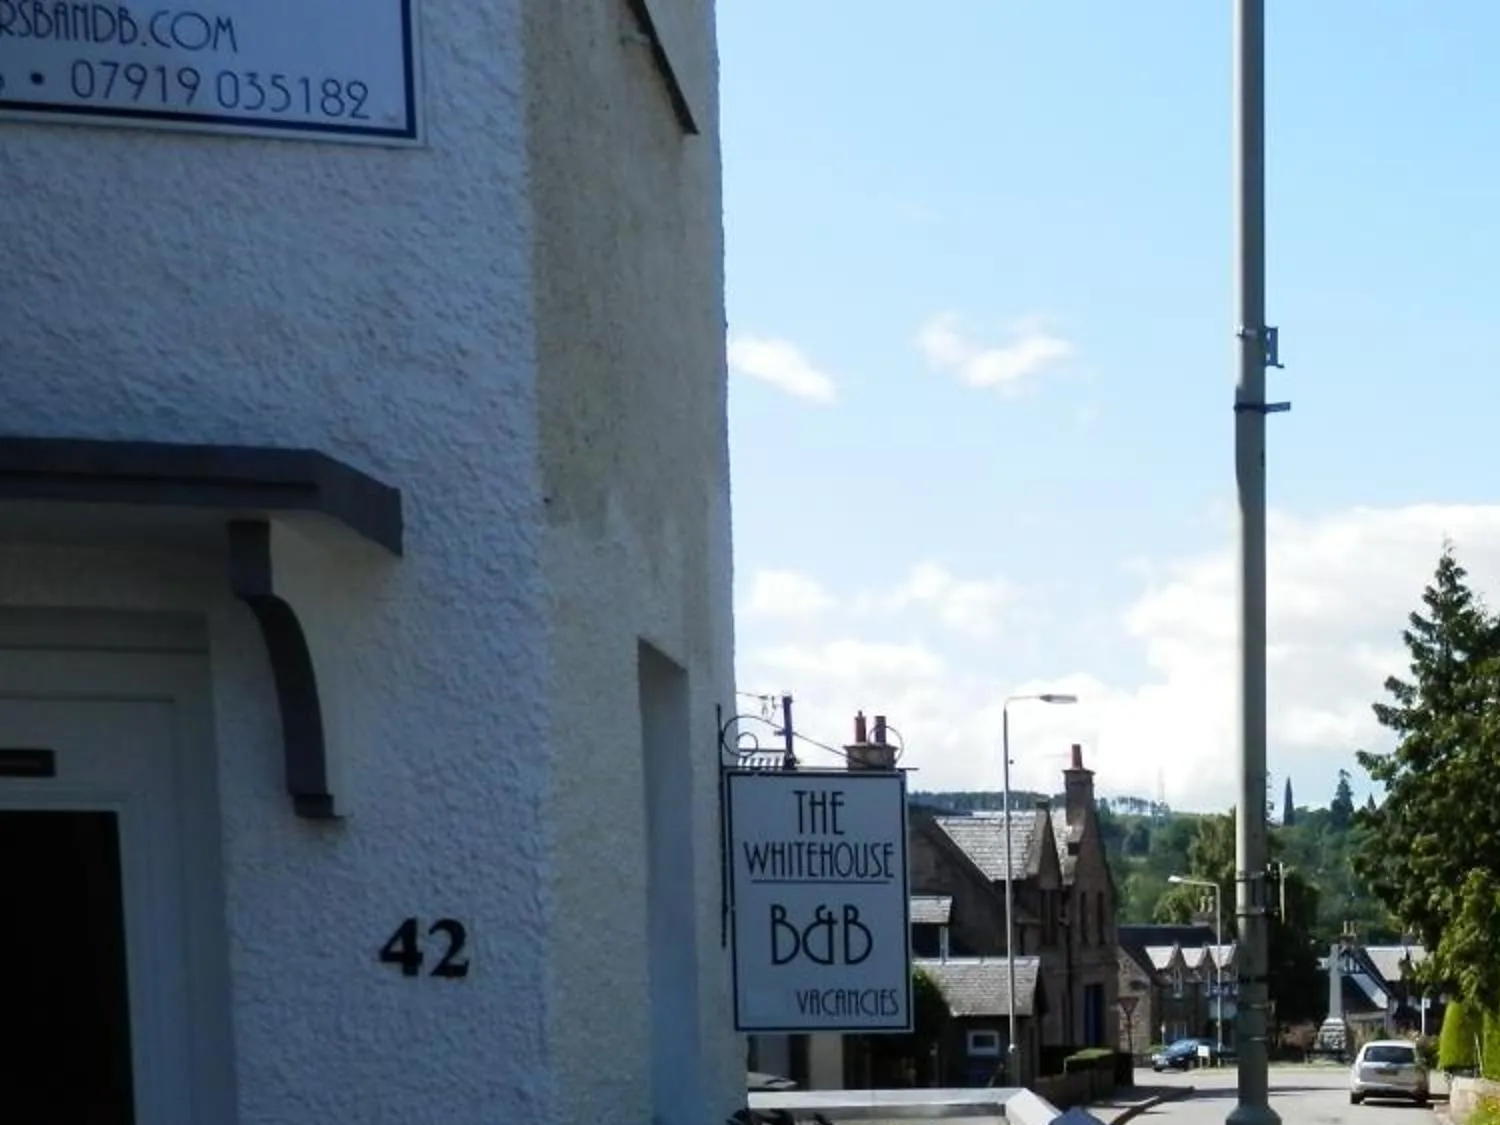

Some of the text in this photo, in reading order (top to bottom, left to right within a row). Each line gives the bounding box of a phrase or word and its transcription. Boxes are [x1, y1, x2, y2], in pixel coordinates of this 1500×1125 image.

[70, 59, 371, 120] 07919 035182
[793, 790, 846, 836] THE
[743, 841, 896, 879] WHITEHOUSE
[379, 917, 470, 977] 42
[770, 903, 873, 966] B&B
[796, 988, 900, 1017] VACANCIES
